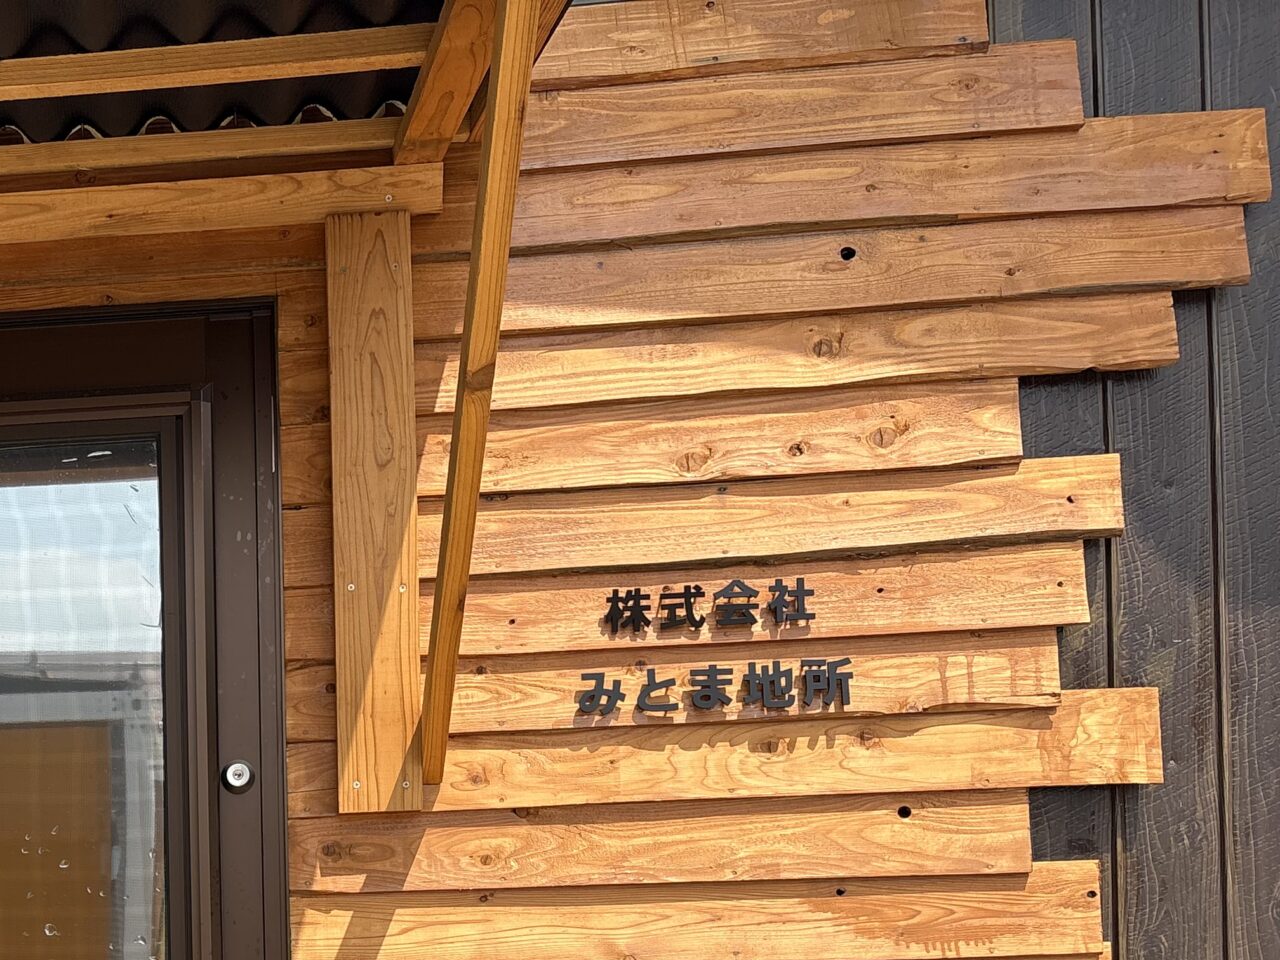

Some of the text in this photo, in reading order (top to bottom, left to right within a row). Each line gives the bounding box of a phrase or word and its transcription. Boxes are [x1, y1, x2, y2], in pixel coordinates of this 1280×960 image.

[604, 577, 816, 634] 株式会社
[578, 657, 854, 715] みとま地所
